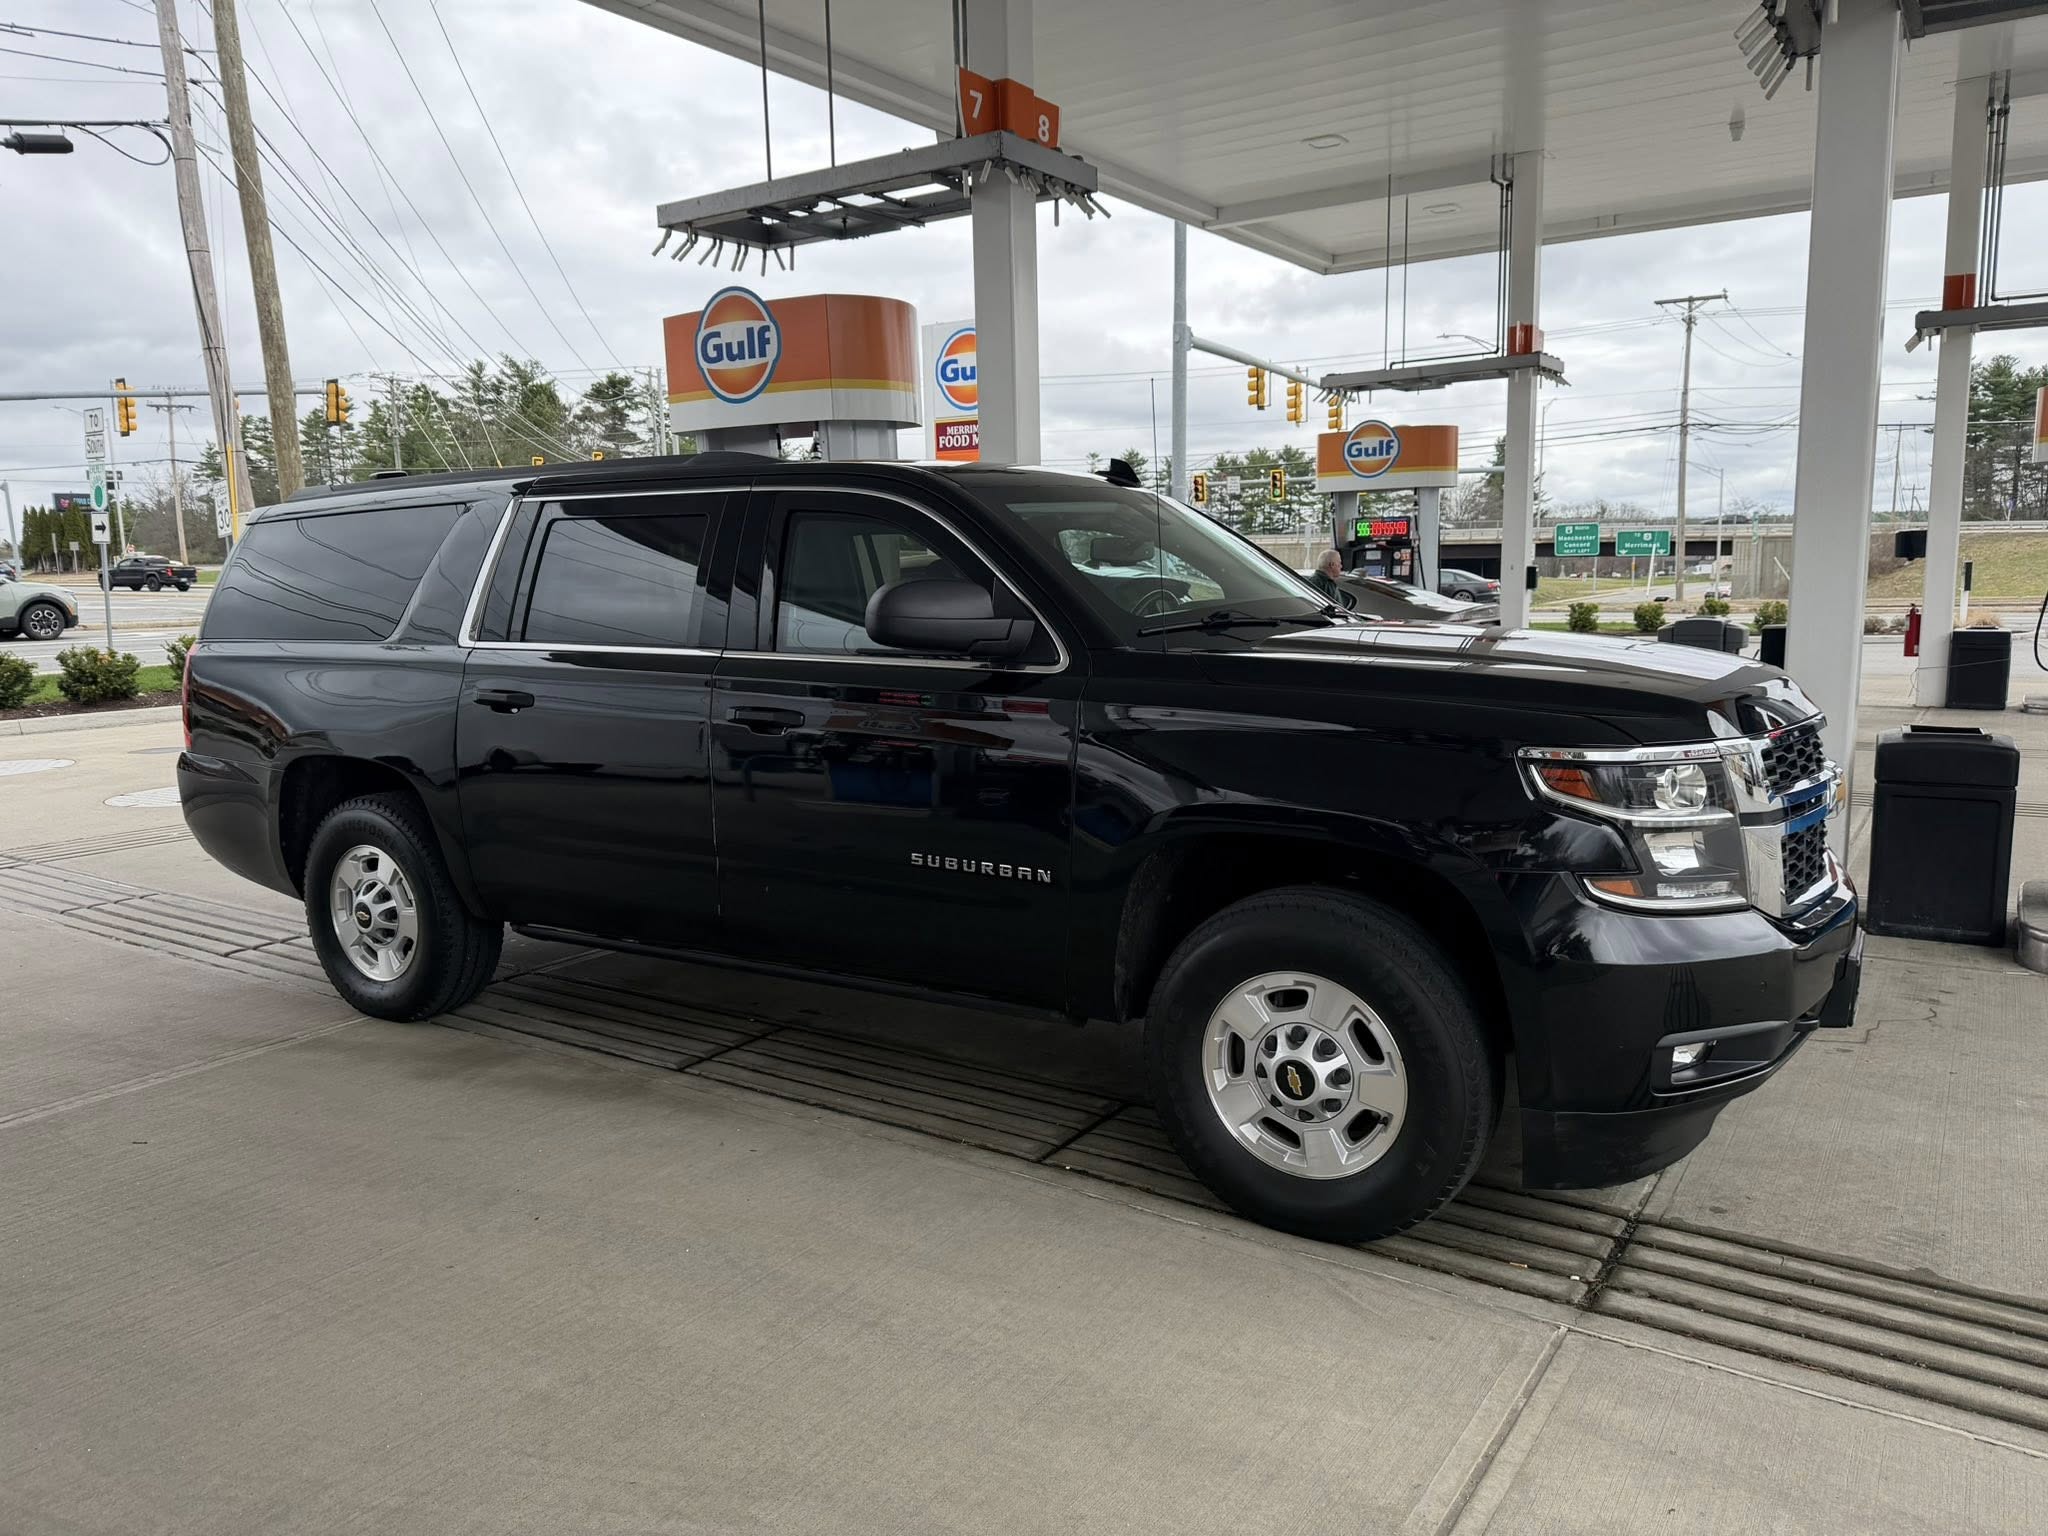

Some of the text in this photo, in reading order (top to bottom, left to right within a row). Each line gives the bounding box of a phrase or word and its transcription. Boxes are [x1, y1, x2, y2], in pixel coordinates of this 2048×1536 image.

[969, 90, 982, 119] 7
[1038, 114, 1049, 142] 8
[700, 325, 771, 365] Gulf
[89, 413, 99, 428] TO
[87, 439, 104, 454] SOUTH
[939, 434, 970, 449] FOOD
[1347, 439, 1394, 458] Gulf
[218, 509, 230, 530] 30
[911, 853, 1051, 883] SUBURBAN
